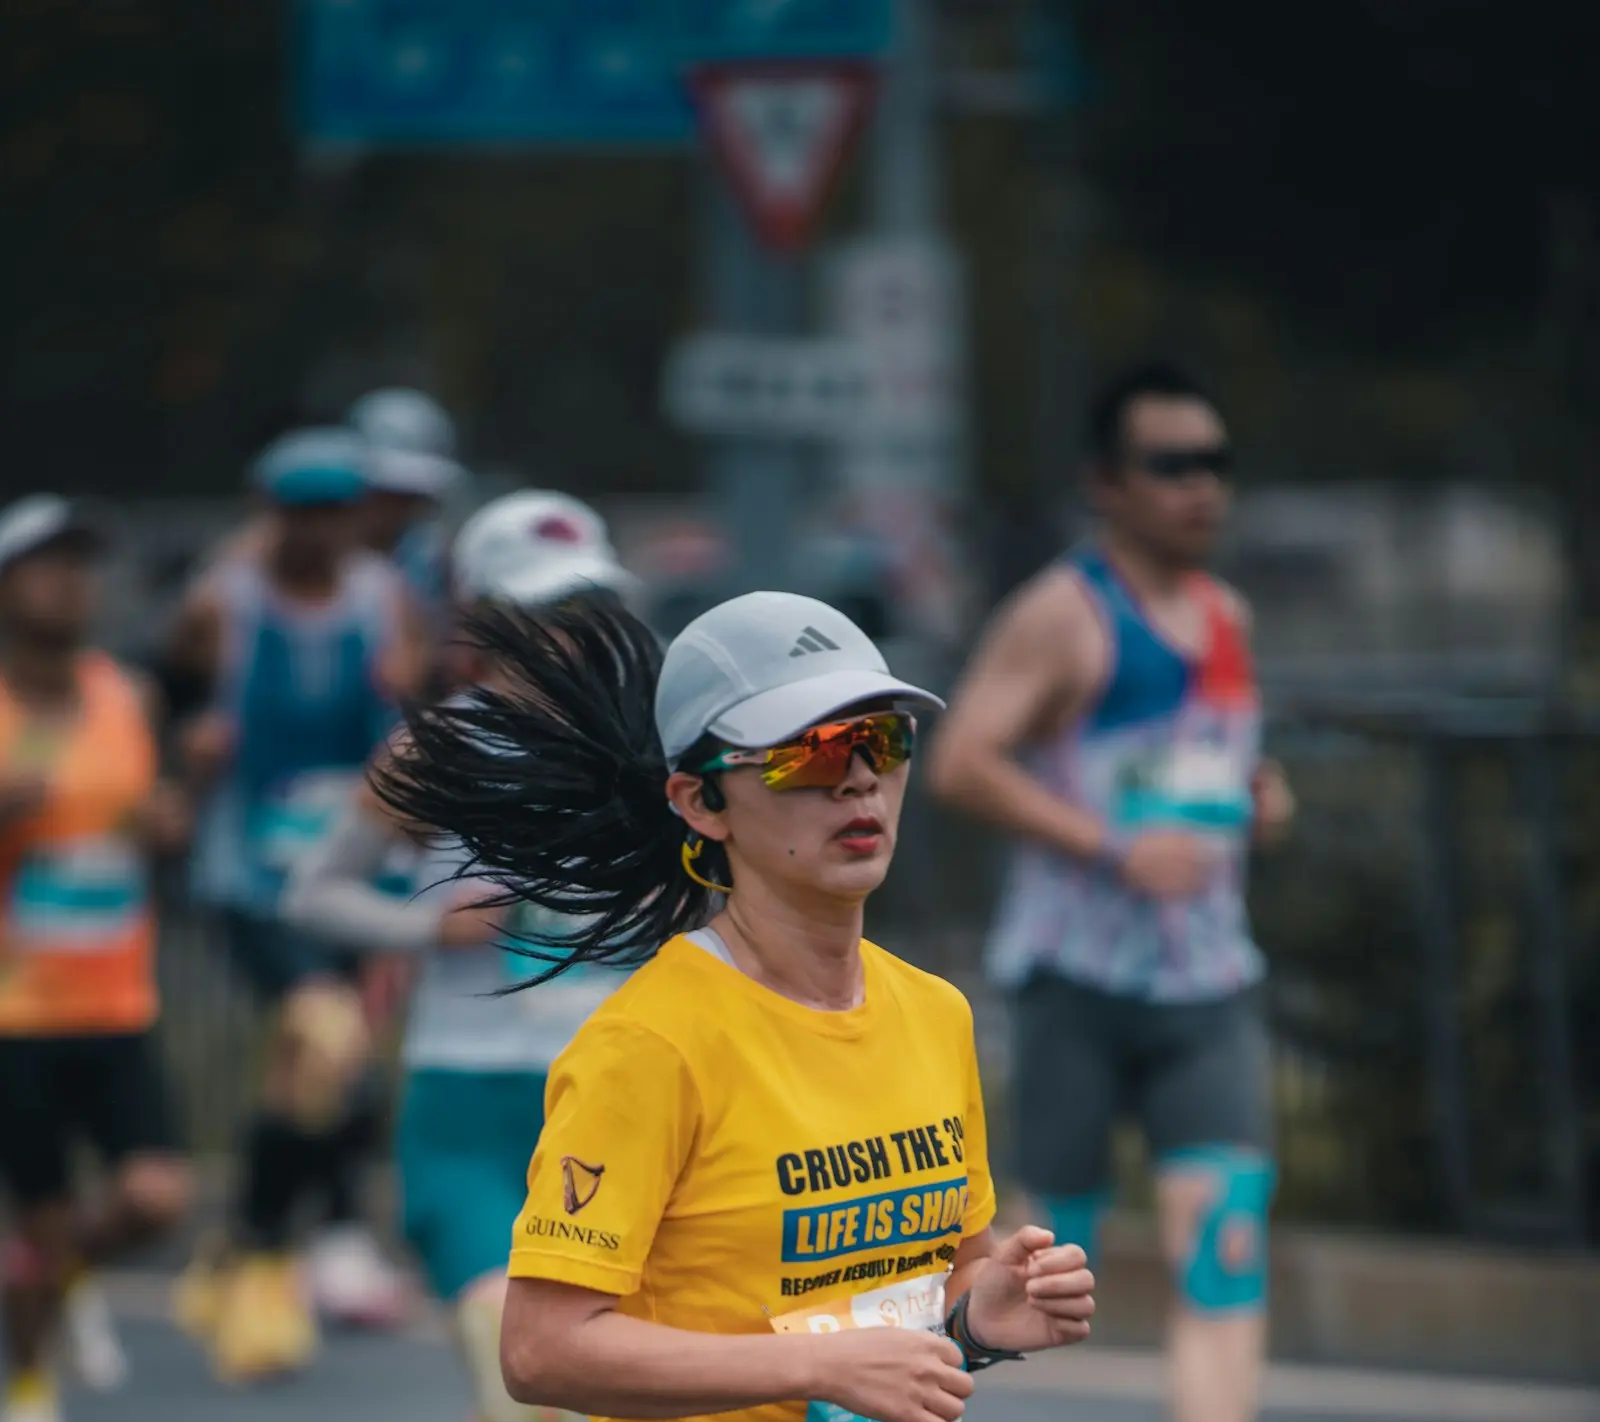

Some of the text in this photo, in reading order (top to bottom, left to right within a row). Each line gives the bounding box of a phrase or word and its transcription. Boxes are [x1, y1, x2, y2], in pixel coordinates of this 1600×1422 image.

[776, 1136, 891, 1195] CRUSH
[890, 1124, 949, 1173] THE
[526, 1216, 621, 1250] GUINNESS
[796, 1206, 860, 1254] LIFE
[864, 1199, 895, 1242] IS
[781, 1269, 842, 1296] RECOVER
